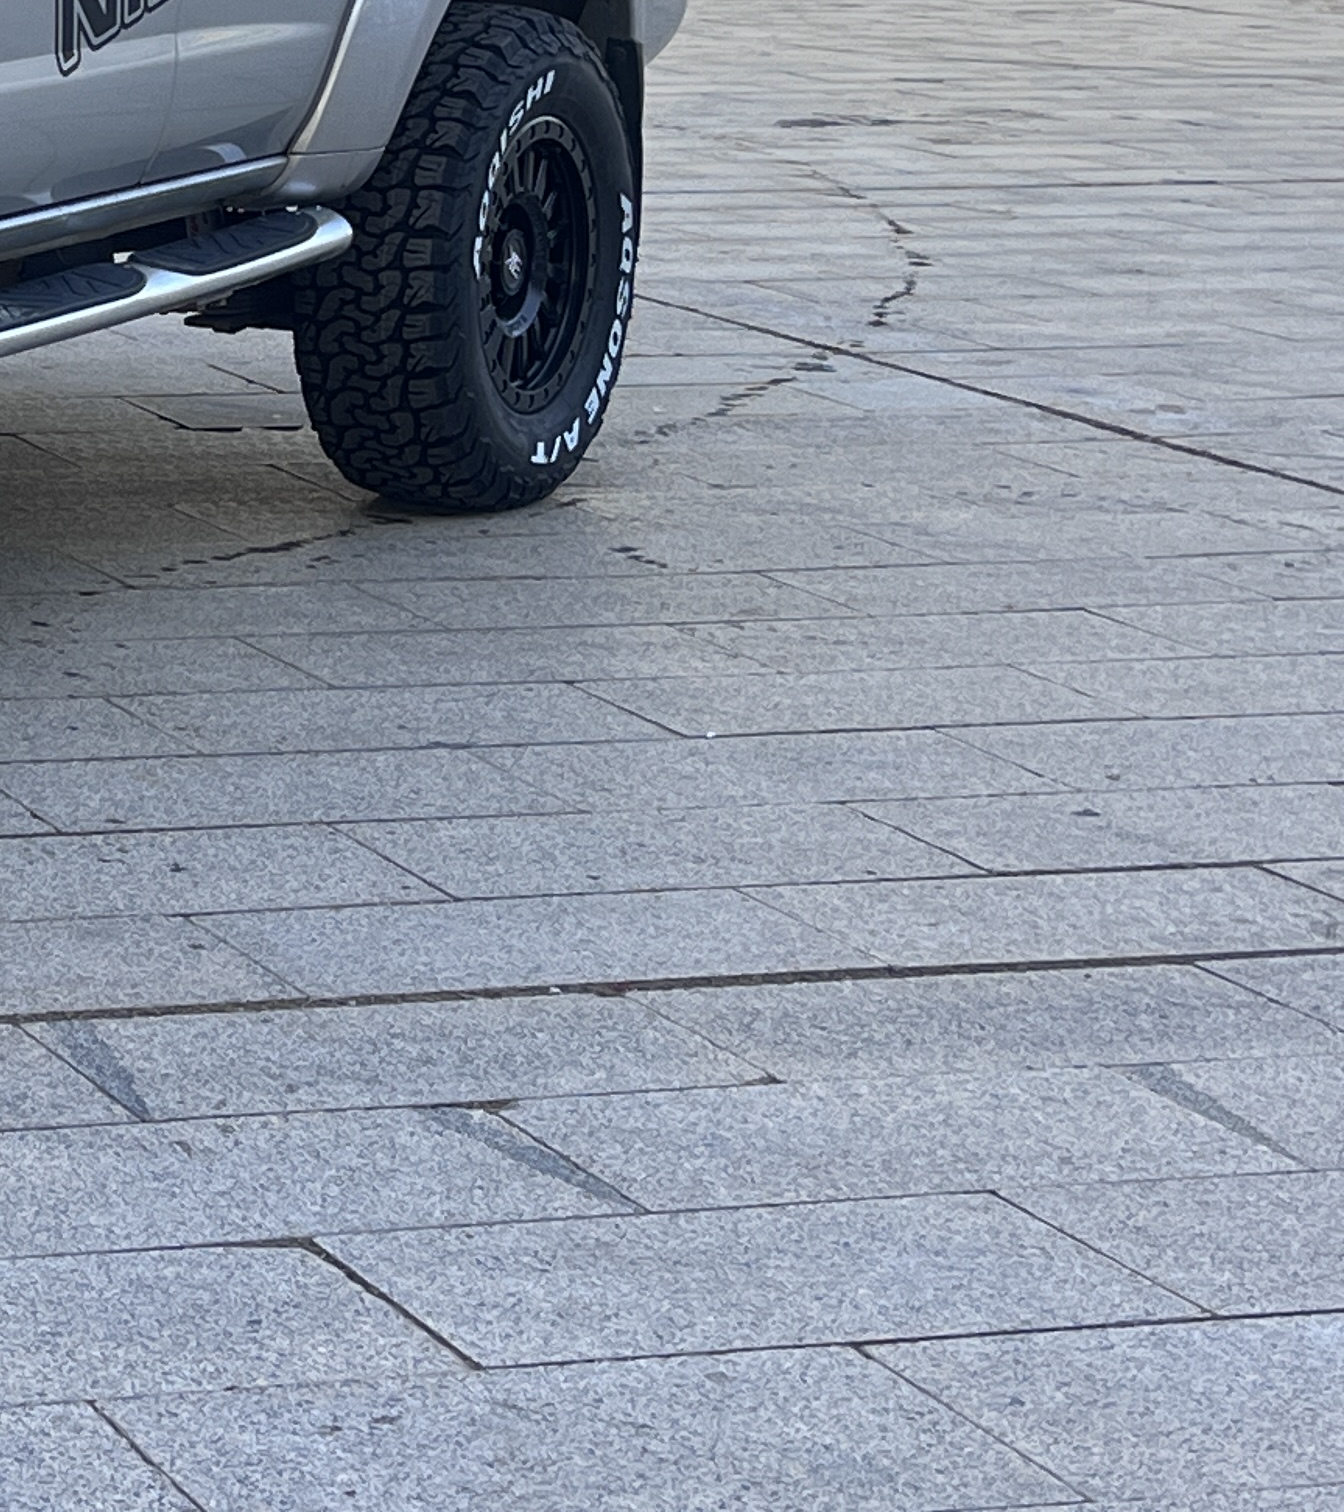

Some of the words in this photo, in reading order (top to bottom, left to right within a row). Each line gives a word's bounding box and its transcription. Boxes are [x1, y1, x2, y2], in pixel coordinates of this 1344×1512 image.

[472, 69, 556, 279] AOQISHI
[583, 193, 633, 424] AQSONE
[530, 417, 581, 465] A/T
